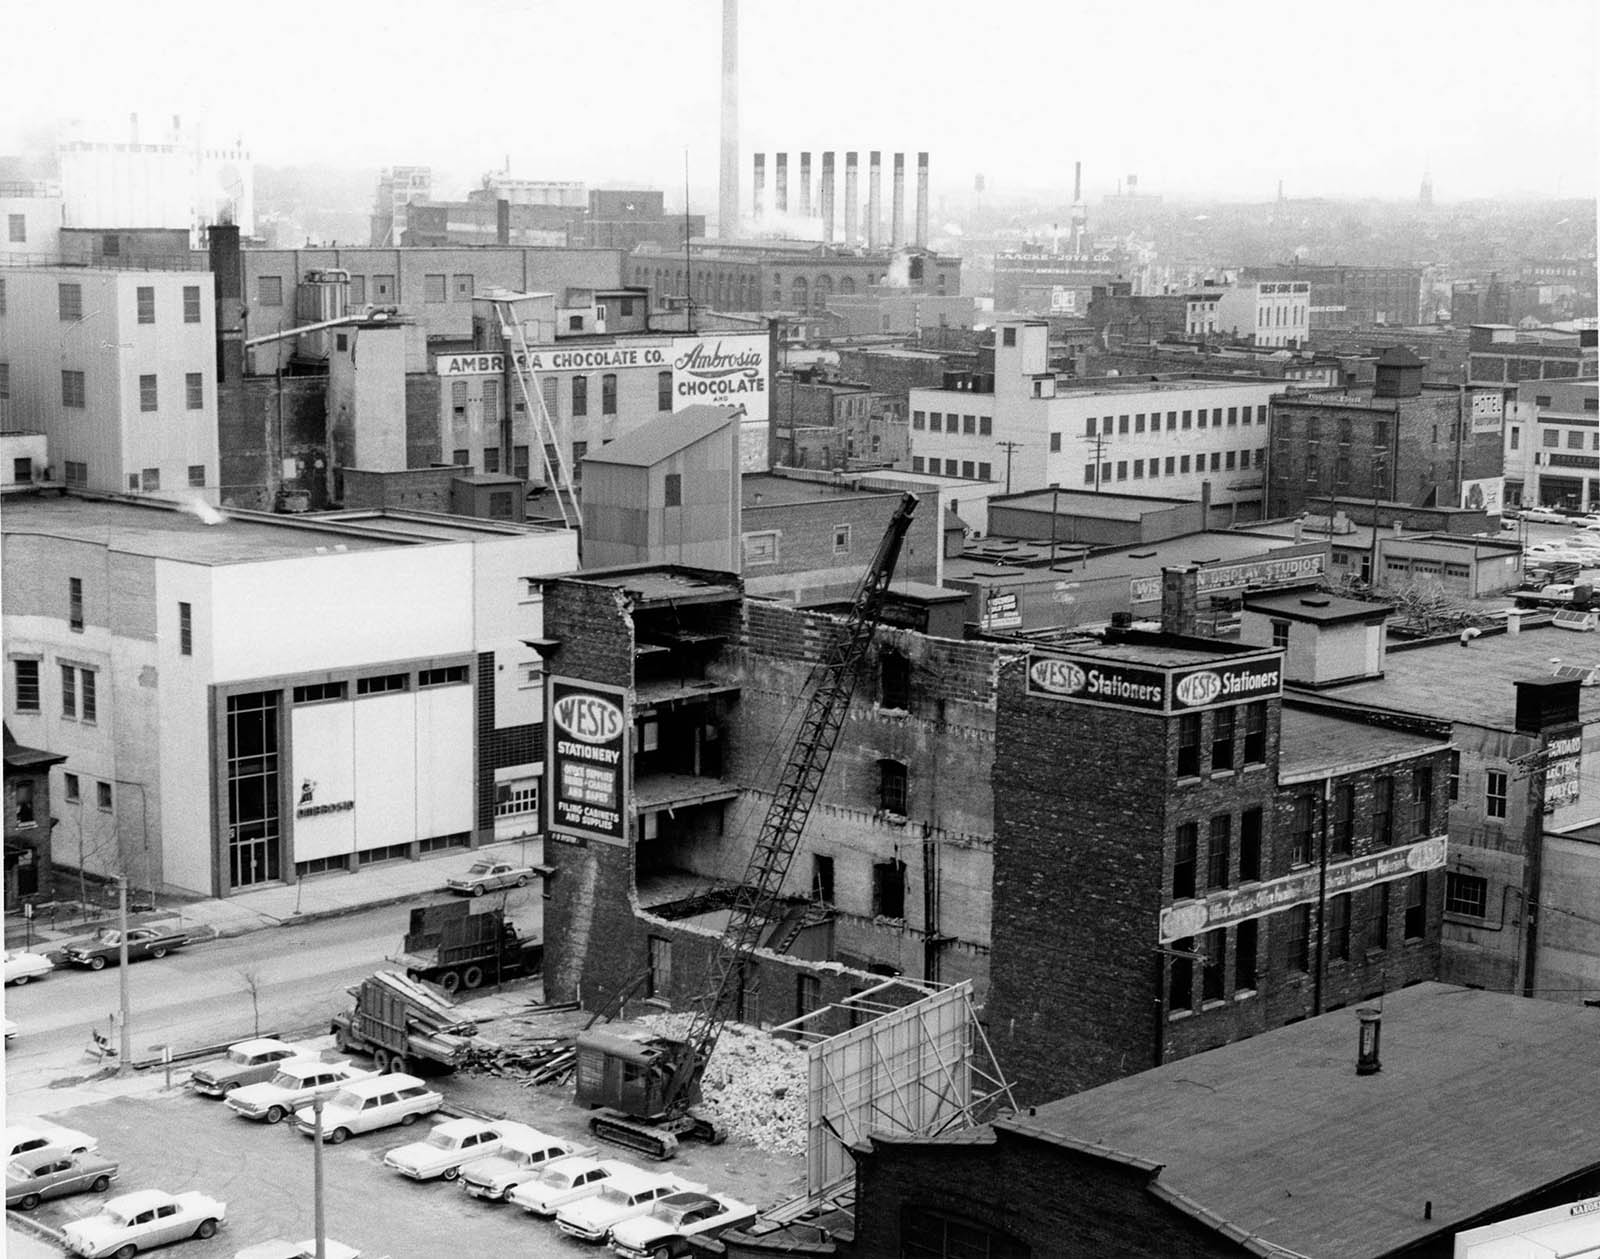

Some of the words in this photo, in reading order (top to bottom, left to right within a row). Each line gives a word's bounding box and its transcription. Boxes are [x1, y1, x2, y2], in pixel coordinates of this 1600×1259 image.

[449, 353, 543, 373] AMBRSA
[553, 350, 637, 369] CHOCOLATE
[645, 349, 665, 364] CO.
[674, 340, 762, 370] Ambrosia
[678, 378, 765, 396] CHOCOLATE
[1211, 569, 1261, 584] DISPLAY
[1265, 557, 1321, 576] STUDIOS
[1088, 670, 1161, 701] Stationers
[1222, 670, 1278, 694] Stationers
[557, 741, 620, 764] STATIONERY
[558, 801, 583, 815] FILING
[584, 807, 619, 823] CABINETS
[565, 812, 580, 823] AND
[581, 816, 613, 830] SUPPLIES
